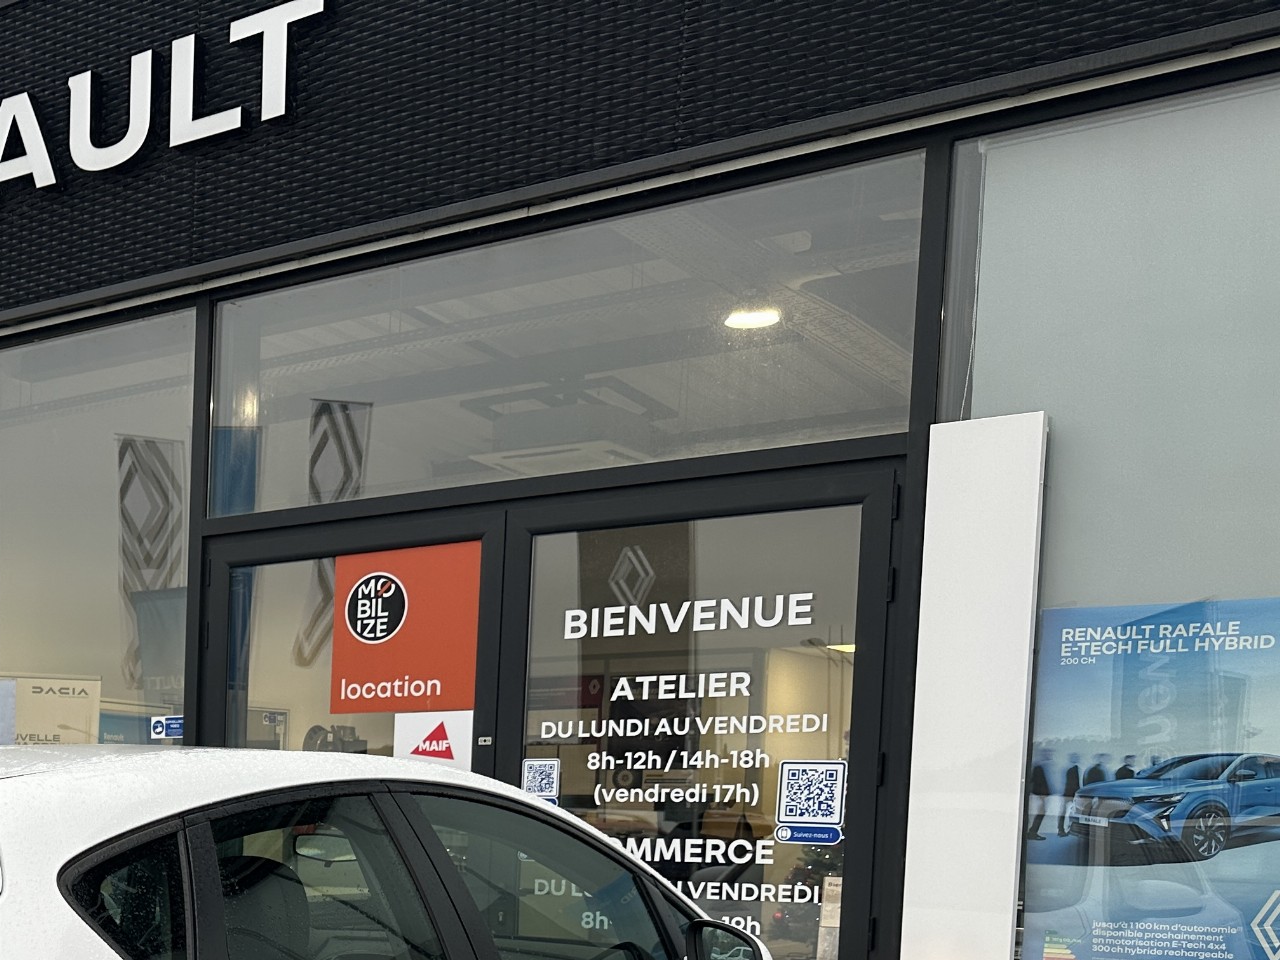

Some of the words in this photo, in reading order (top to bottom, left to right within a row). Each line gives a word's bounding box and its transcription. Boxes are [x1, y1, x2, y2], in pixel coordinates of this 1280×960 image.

[563, 592, 813, 639] BIENVENUE
[1062, 625, 1155, 642] RENAULT
[1159, 621, 1241, 638] RAFALE
[1061, 640, 1132, 657] E-TECH
[1137, 638, 1189, 654] FULL
[1194, 634, 1276, 652] HYBRID
[1060, 657, 1079, 665] 200
[1081, 656, 1096, 665] CH
[32, 686, 88, 696] DACIA
[340, 675, 441, 700] location
[610, 672, 751, 701] ATELIER
[541, 721, 573, 739] DU
[577, 718, 650, 738] LUNDI
[654, 717, 690, 736] AU
[695, 714, 828, 735] VENDREDI
[418, 739, 450, 752] MAIF
[587, 751, 662, 770] 8h-12h
[681, 748, 770, 769] 14h-18h
[593, 783, 708, 806] (vendredi
[712, 784, 760, 806] 17h)
[793, 831, 829, 839] Suivez-nous
[534, 879, 567, 896] DU
[687, 881, 819, 904] VENDREDI
[581, 911, 613, 930] 8h
[1092, 928, 1143, 938] disponible
[1144, 931, 1224, 942] prochainement
[1105, 938, 1170, 947] motorisation
[1171, 940, 1206, 949] E-Tech
[1207, 942, 1227, 951] 4x4
[1092, 944, 1111, 952] 300
[1111, 945, 1124, 953] ch
[1124, 946, 1163, 956] hybride
[1164, 948, 1234, 960] rechargeable
